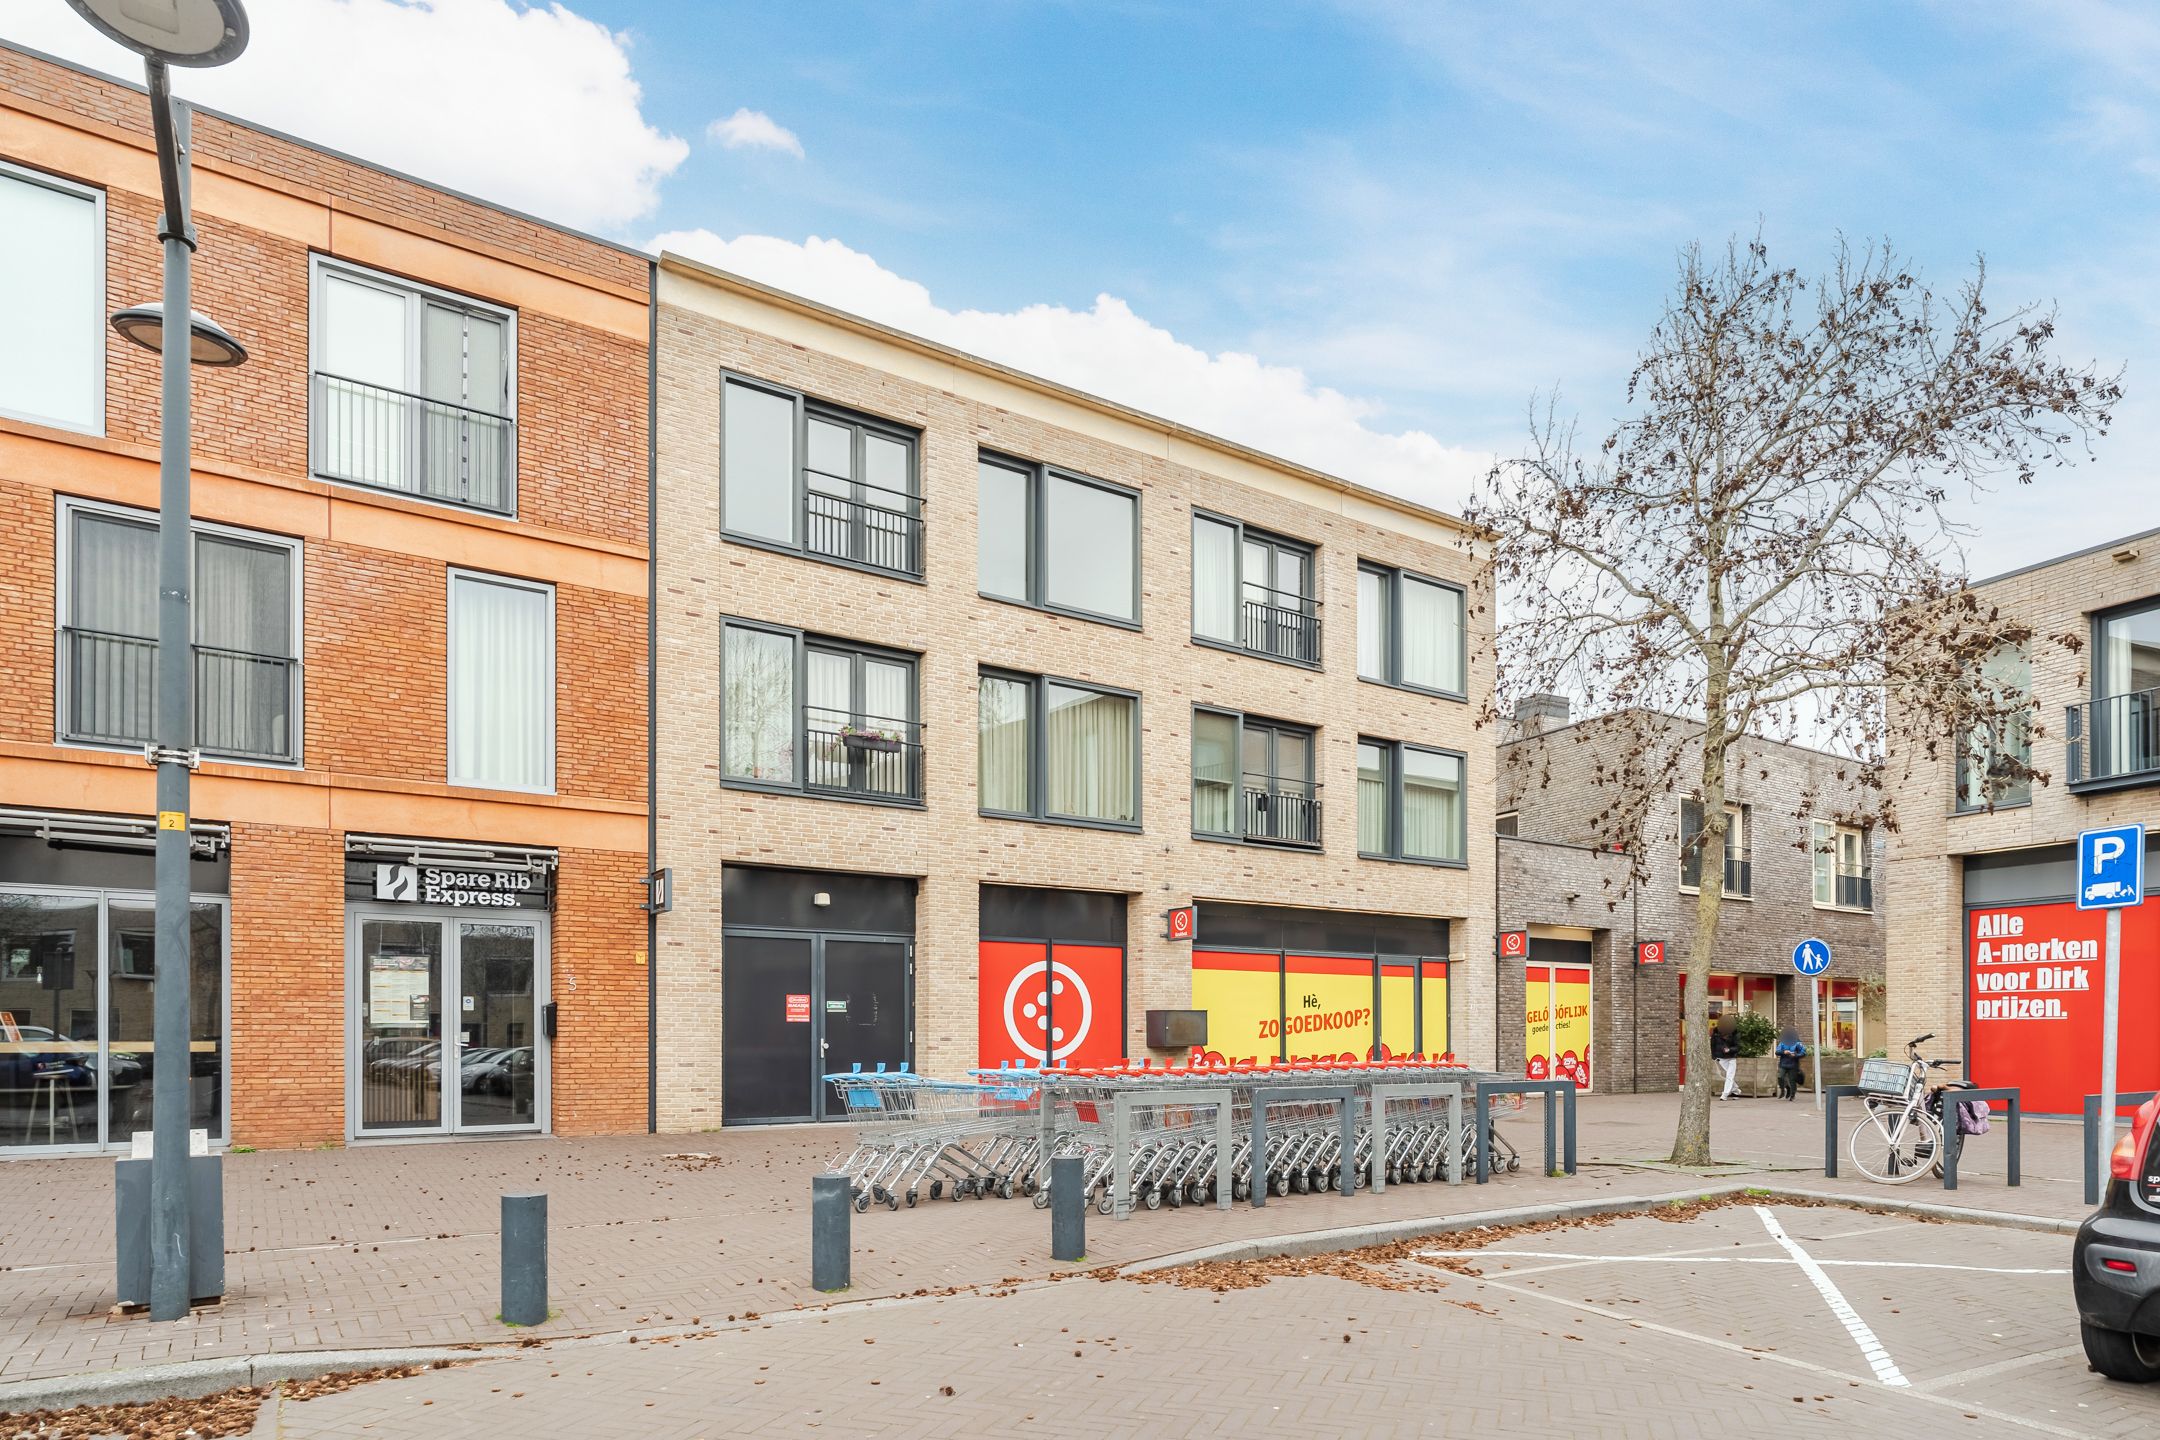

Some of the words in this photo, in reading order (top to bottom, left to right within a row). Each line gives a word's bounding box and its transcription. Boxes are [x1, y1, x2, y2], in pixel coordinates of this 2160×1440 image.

[2094, 836, 2125, 875] P
[425, 868, 491, 888] Spare
[494, 871, 531, 890] Rib
[425, 885, 521, 907] Express.
[1977, 913, 2024, 937] Alle
[1977, 938, 2098, 964] A-merken
[1976, 971, 2030, 992] voor
[2036, 966, 2090, 990] Dirk
[1303, 993, 1321, 1010] Hè,
[1976, 996, 2068, 1020] prijzen.
[1258, 1019, 1280, 1039] ZO
[1285, 1008, 1371, 1035] GOEDKOOP?
